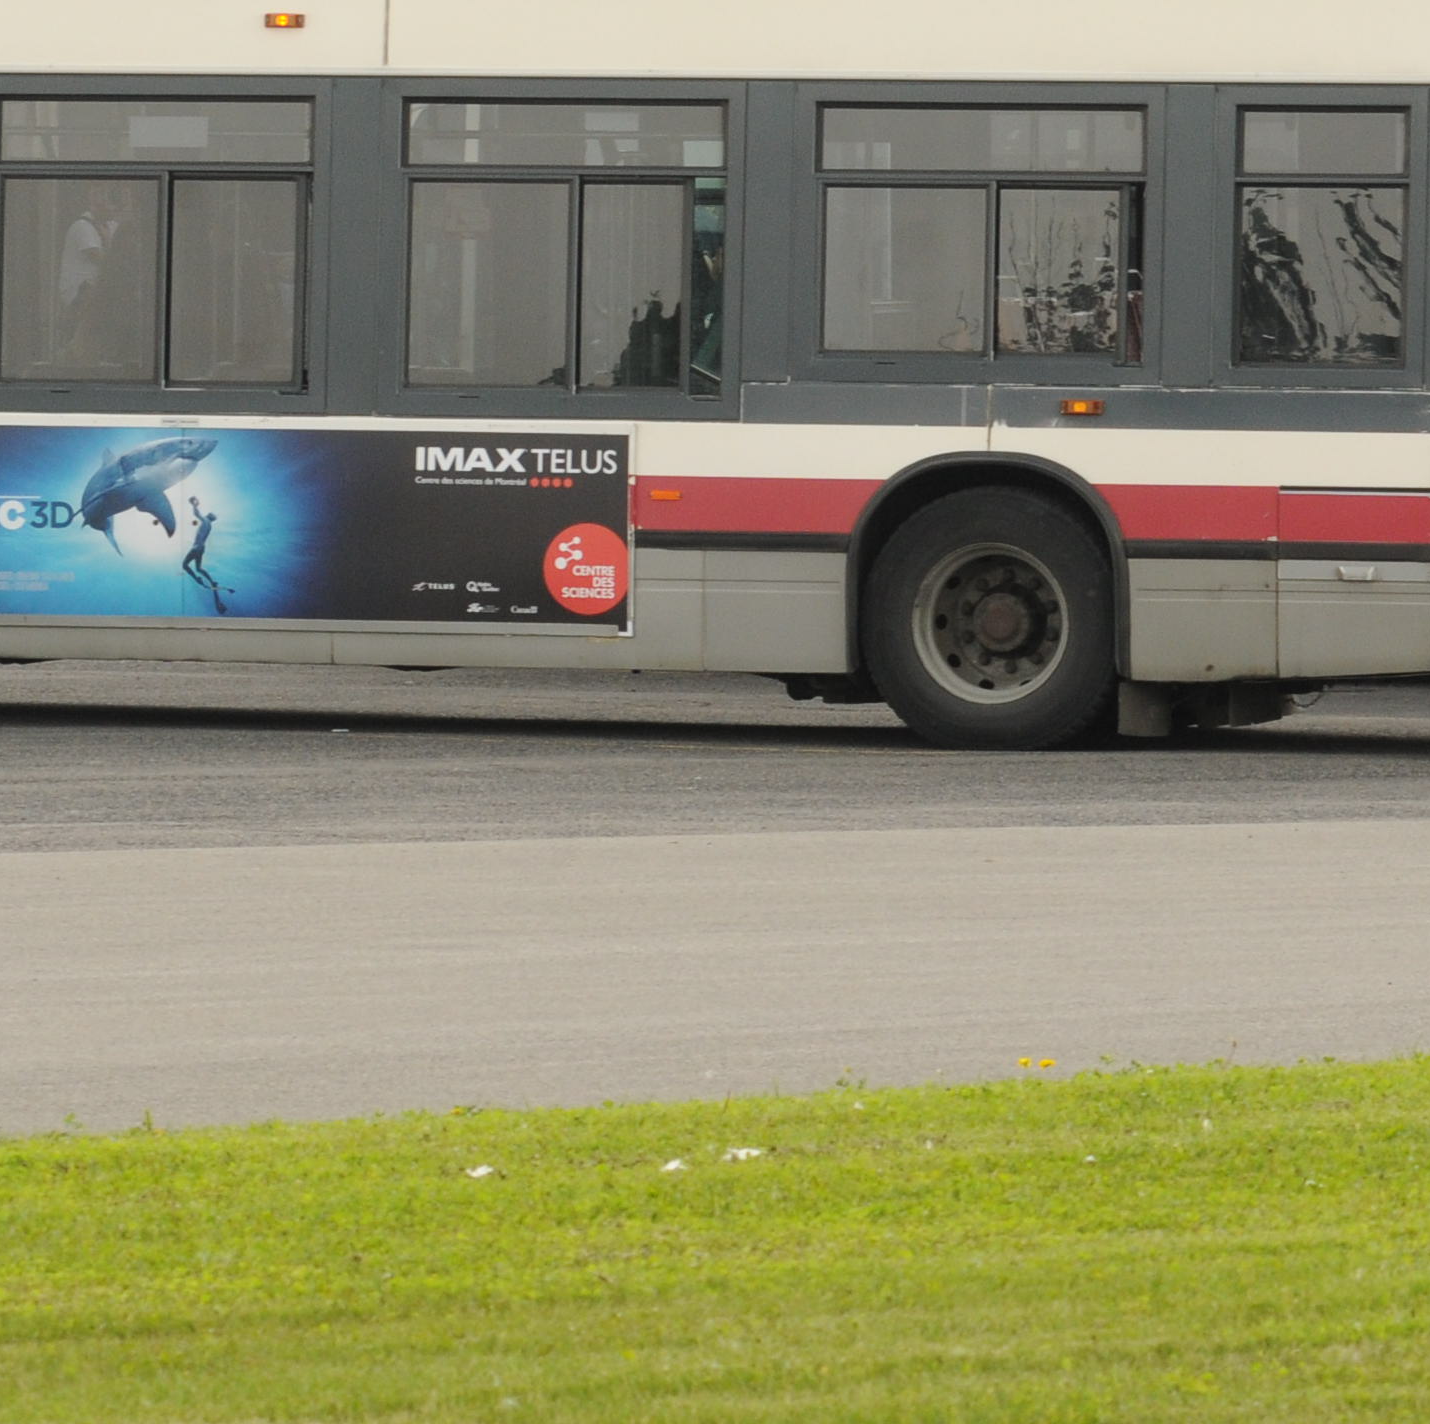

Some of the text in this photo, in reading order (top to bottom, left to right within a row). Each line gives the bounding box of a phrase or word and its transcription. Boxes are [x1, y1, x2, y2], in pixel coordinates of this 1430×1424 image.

[415, 446, 618, 474] IMAX TELUS
[29, 501, 73, 529] 3D
[572, 565, 615, 577] CENTRE
[592, 577, 615, 587] DES
[561, 587, 615, 599] SCIENCES
